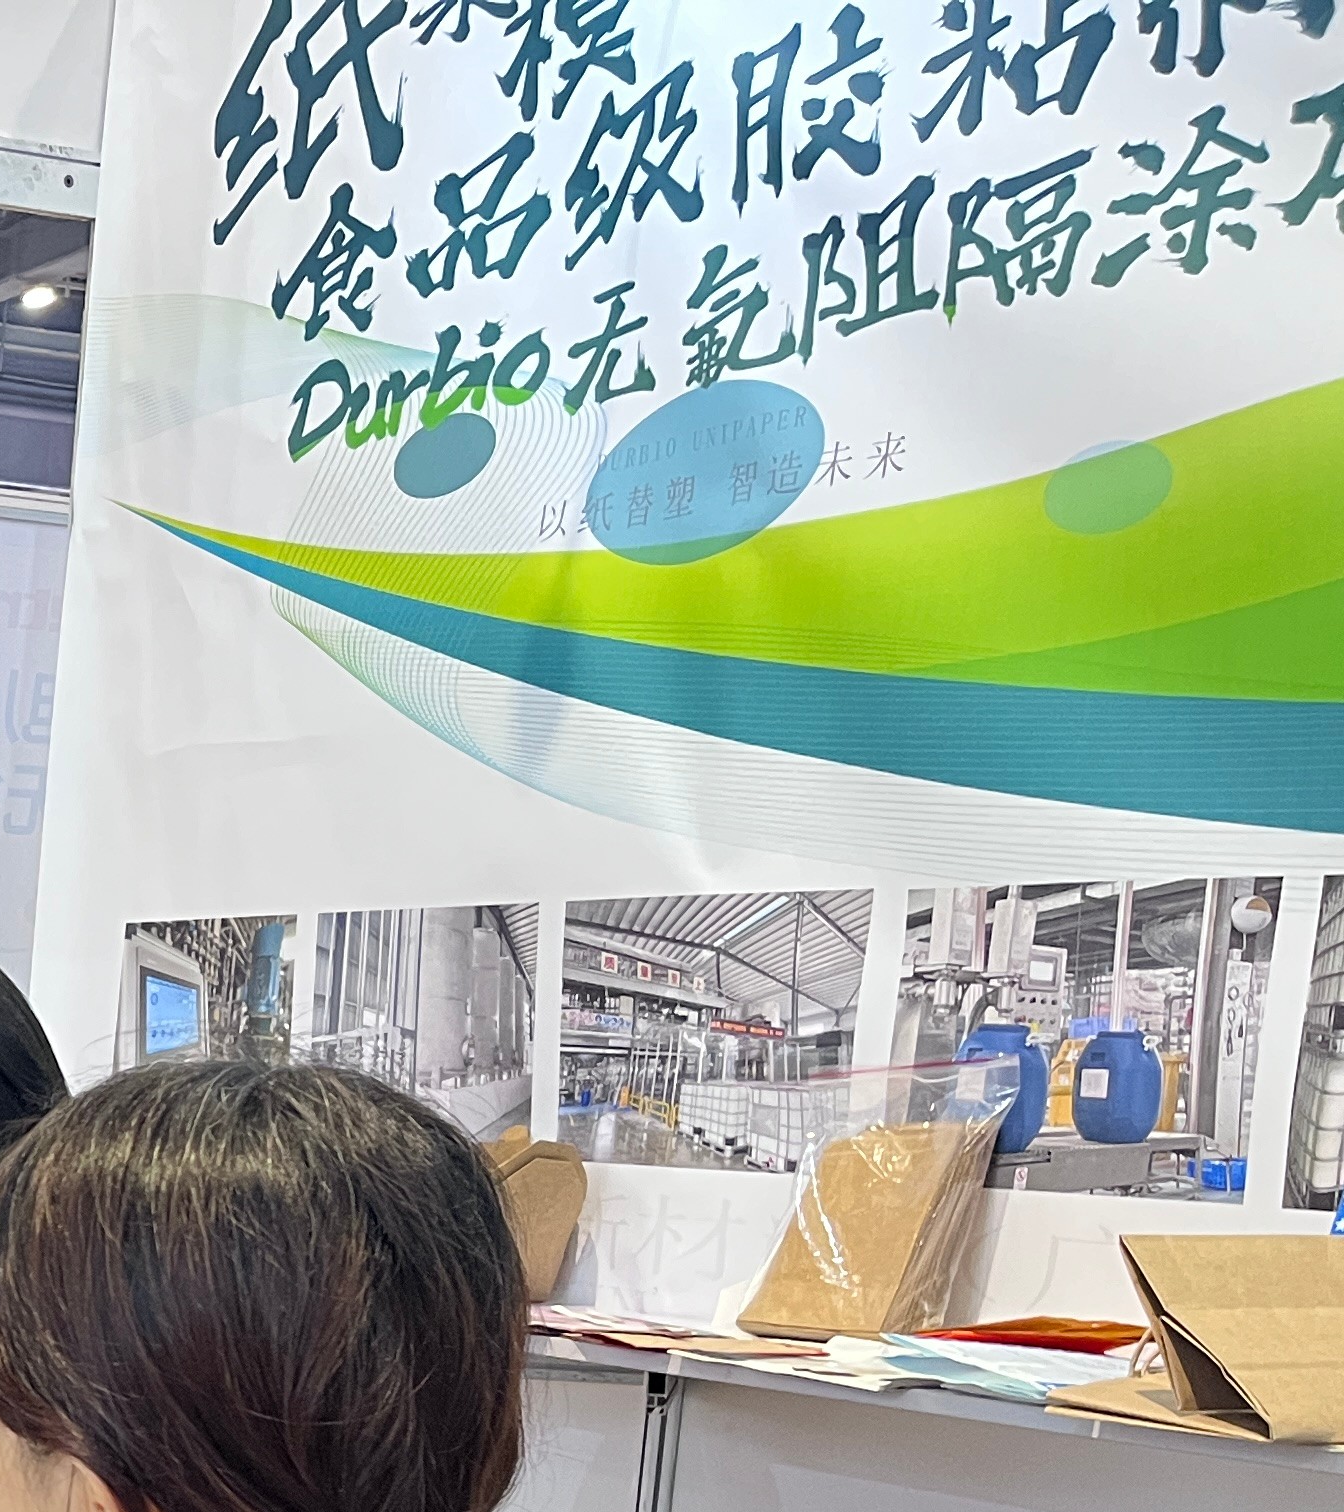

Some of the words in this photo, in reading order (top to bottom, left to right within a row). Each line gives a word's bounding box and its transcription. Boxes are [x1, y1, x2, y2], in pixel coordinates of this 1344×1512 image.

[537, 474, 697, 541] 以纸替塑
[729, 431, 906, 507] 智造未来
